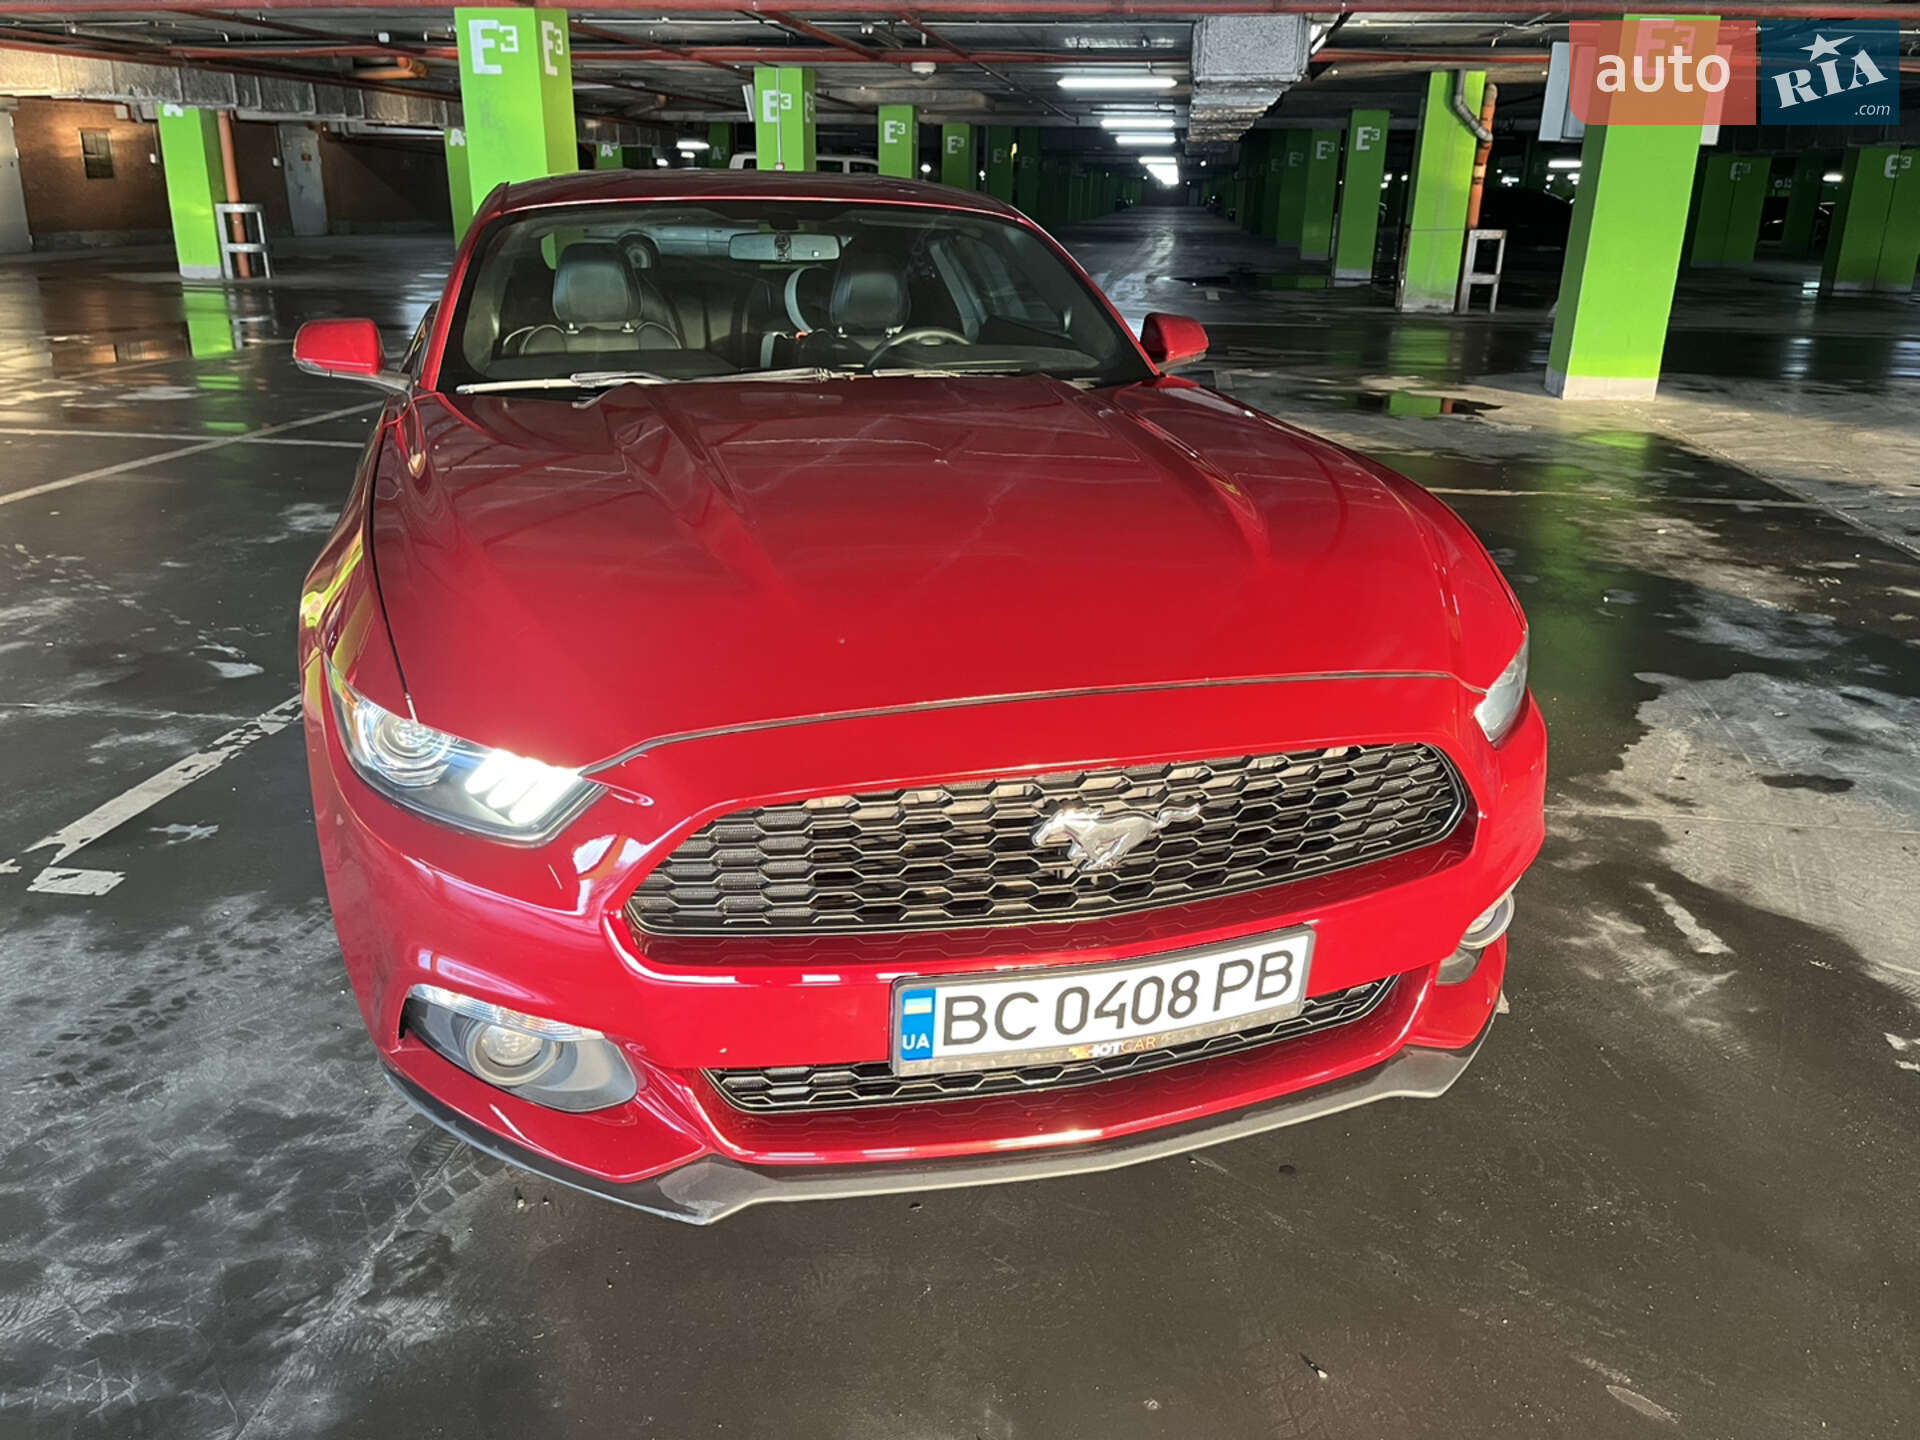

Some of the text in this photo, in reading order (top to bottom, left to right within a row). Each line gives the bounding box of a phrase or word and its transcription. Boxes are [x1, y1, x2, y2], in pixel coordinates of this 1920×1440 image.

[468, 19, 519, 75] E3
[884, 120, 906, 144] E3
[1356, 126, 1381, 151] E3
[943, 950, 1293, 1046] BC 0408 PB
[902, 1033, 930, 1051] UA
